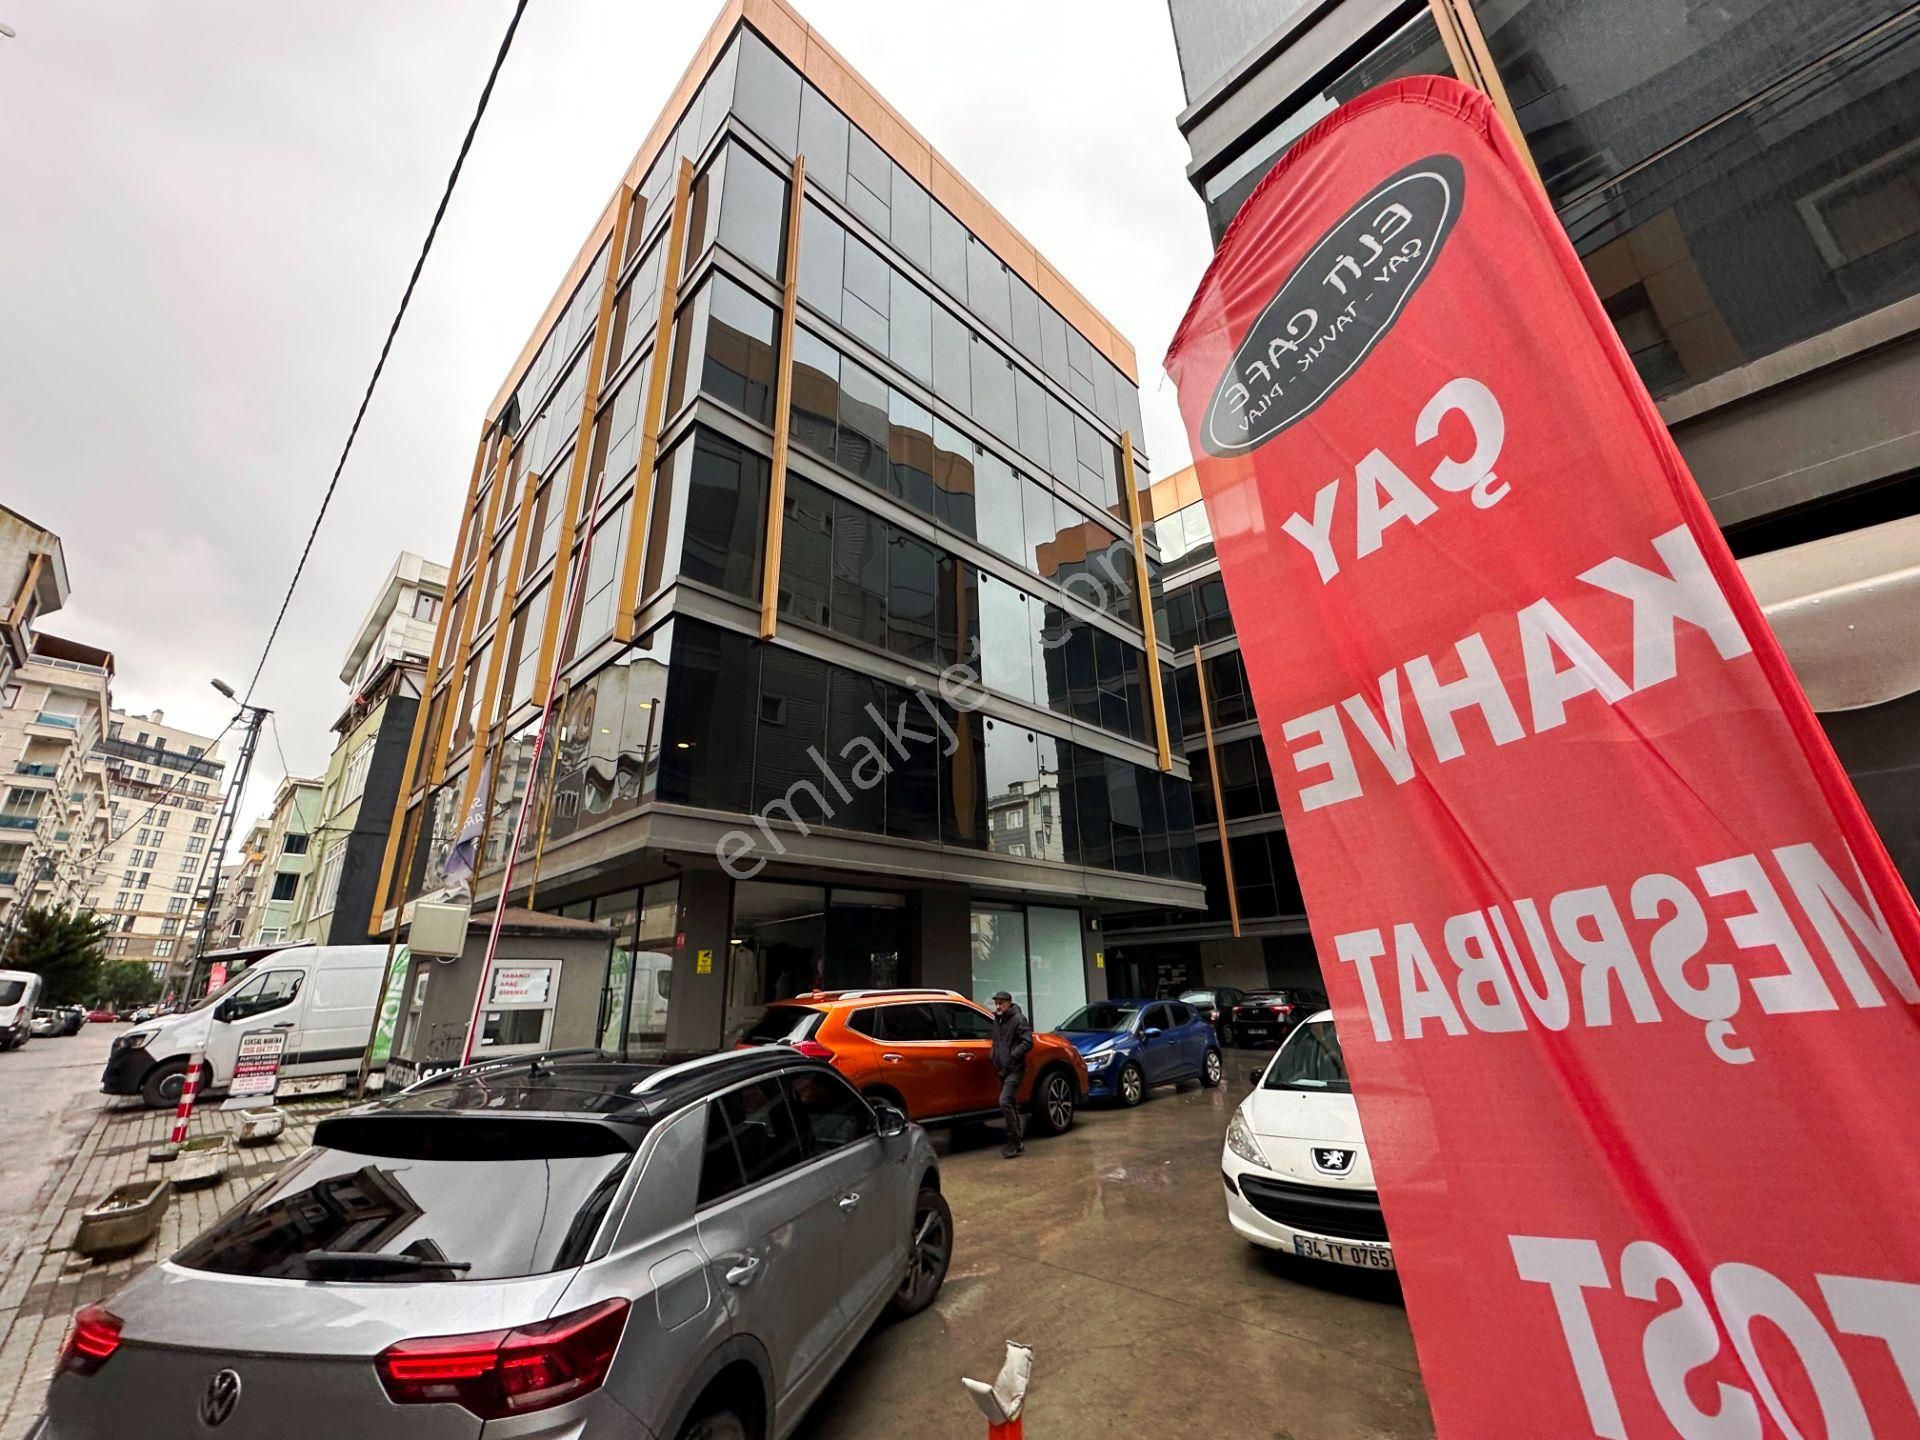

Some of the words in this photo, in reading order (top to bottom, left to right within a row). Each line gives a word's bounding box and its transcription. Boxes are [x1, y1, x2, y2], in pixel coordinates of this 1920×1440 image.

[1304, 1240, 1322, 1258] 34
[1326, 1244, 1343, 1262] TY
[1350, 1247, 1390, 1267] 0765
